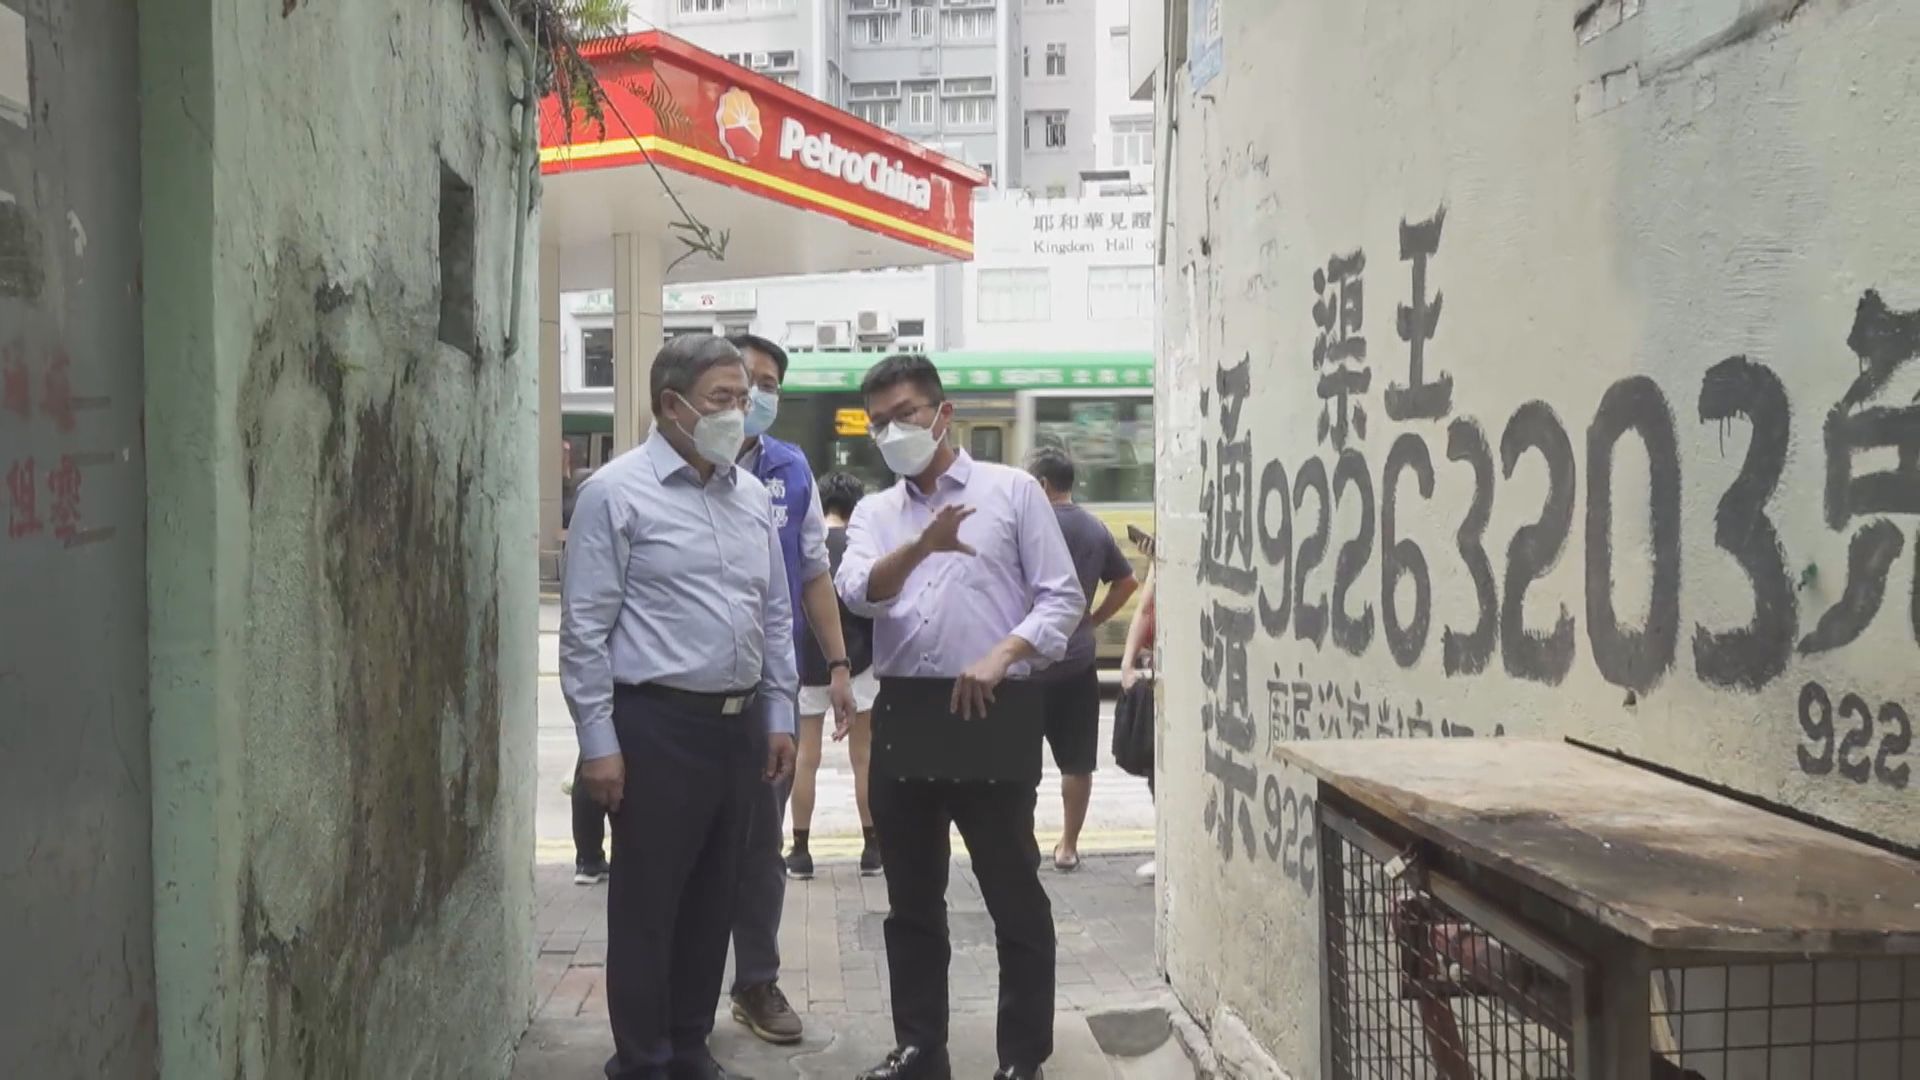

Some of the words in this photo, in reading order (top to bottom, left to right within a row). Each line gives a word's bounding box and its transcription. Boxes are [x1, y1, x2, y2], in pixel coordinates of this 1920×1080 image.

[779, 116, 932, 211] PetroChina
[1033, 239, 1095, 255] Kingdom
[1106, 237, 1134, 252] Hall
[1257, 354, 1799, 695] 92263203
[1798, 679, 1911, 789] 922
